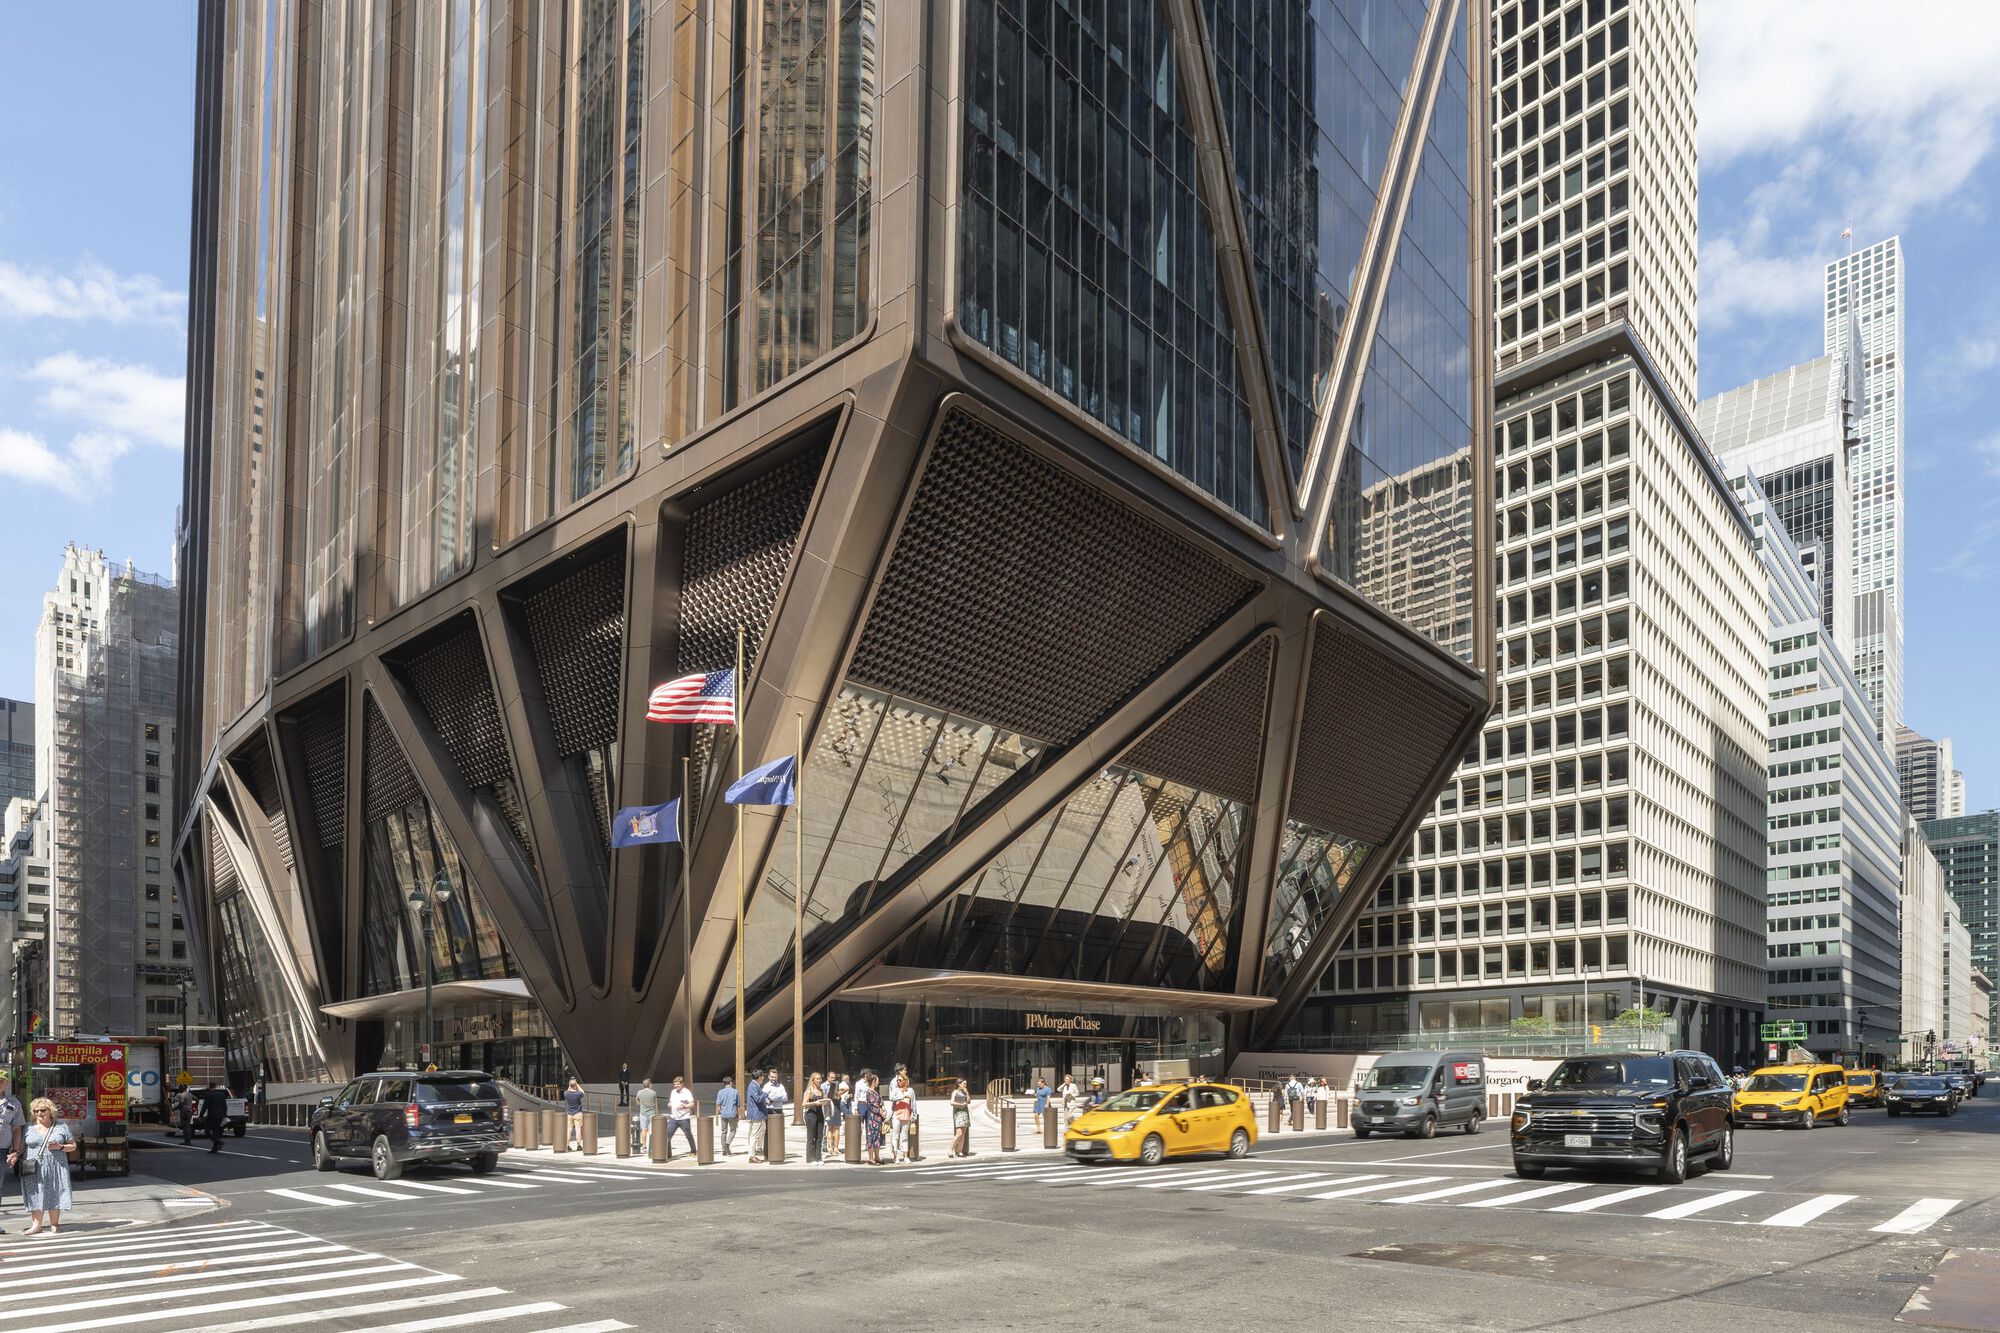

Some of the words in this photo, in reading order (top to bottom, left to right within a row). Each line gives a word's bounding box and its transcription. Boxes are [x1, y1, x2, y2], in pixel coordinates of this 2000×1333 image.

[1025, 1013, 1101, 1033] JPMorganChase
[56, 1045, 102, 1055] Bismilla
[49, 1054, 77, 1063] Halal
[81, 1054, 108, 1063] Food
